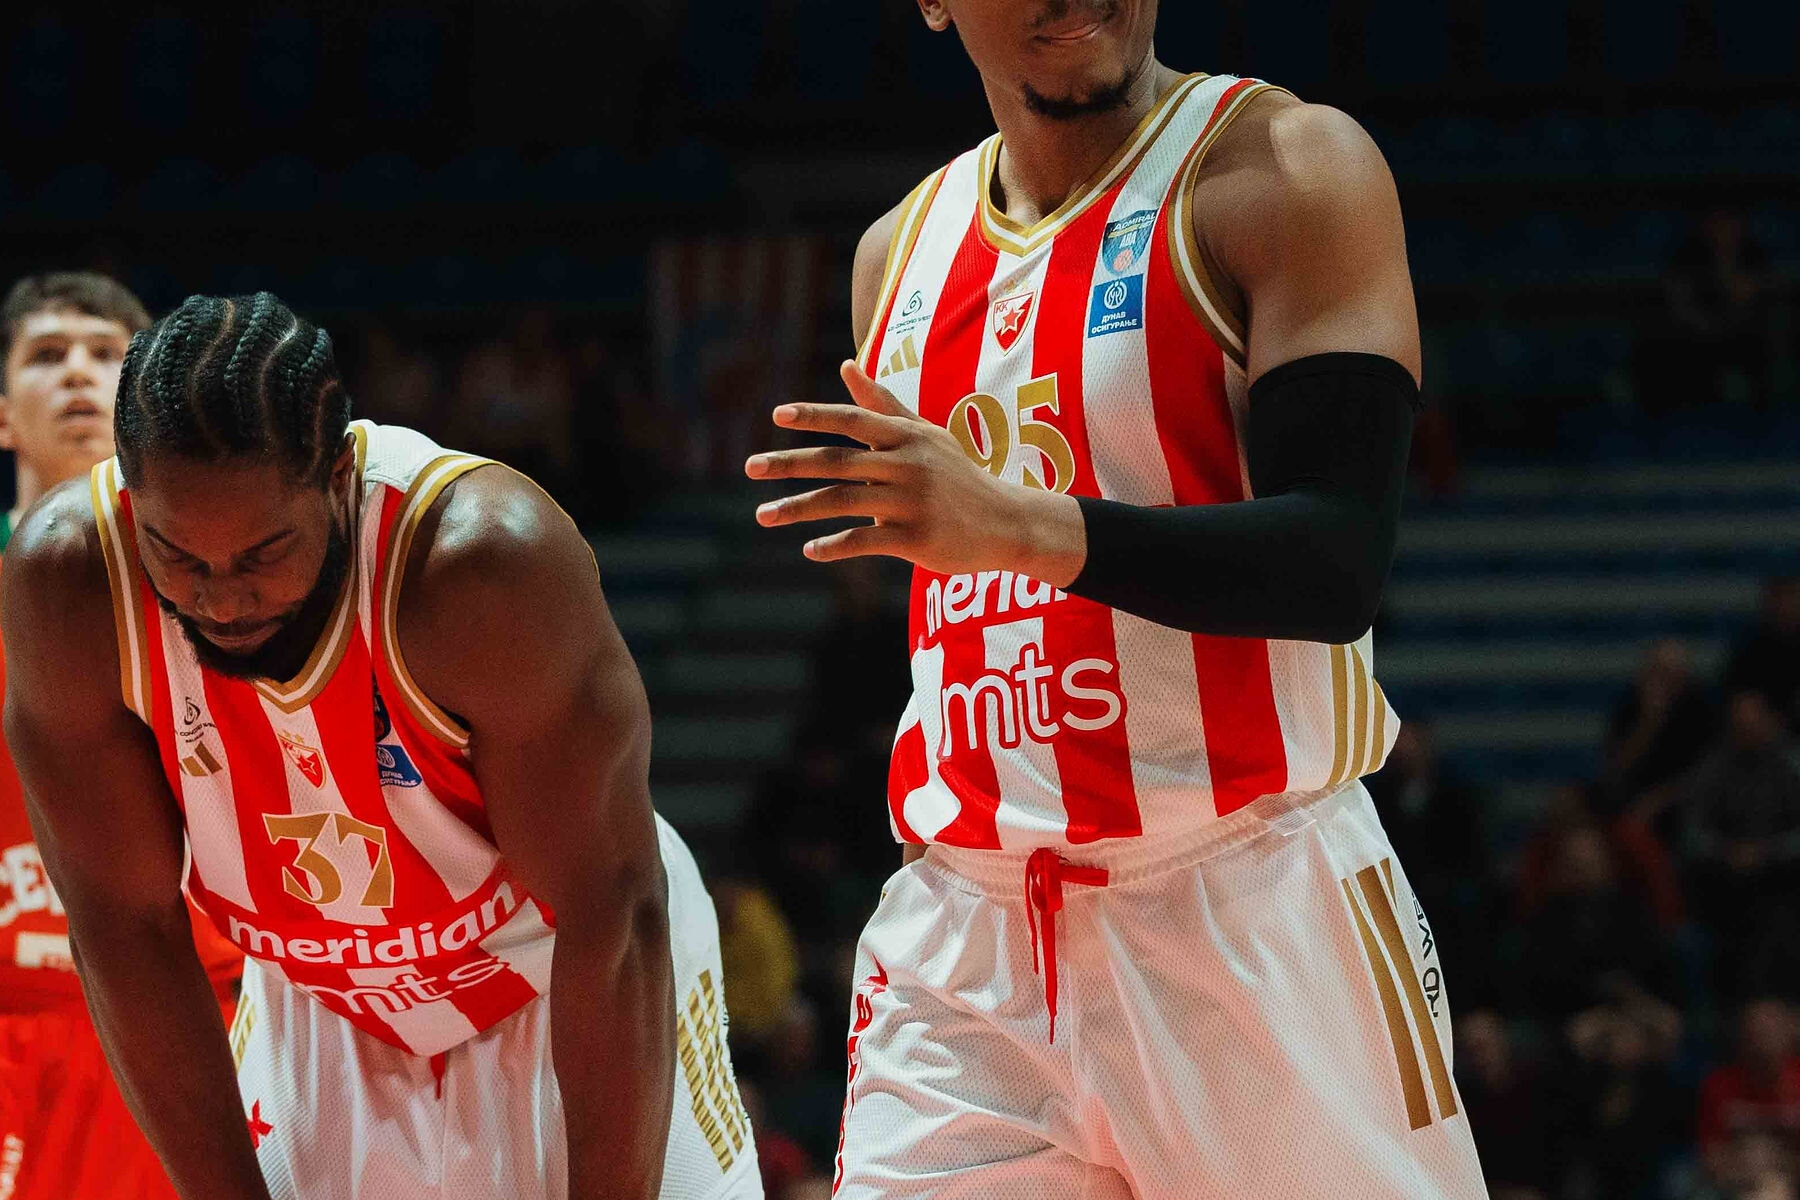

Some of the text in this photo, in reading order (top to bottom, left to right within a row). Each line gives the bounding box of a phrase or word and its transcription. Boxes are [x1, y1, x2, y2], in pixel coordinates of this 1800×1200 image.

[947, 372, 1075, 494] 95
[942, 649, 1121, 757] mts
[262, 812, 394, 909] 37
[229, 881, 517, 965] meridian
[295, 957, 508, 1016] mts
